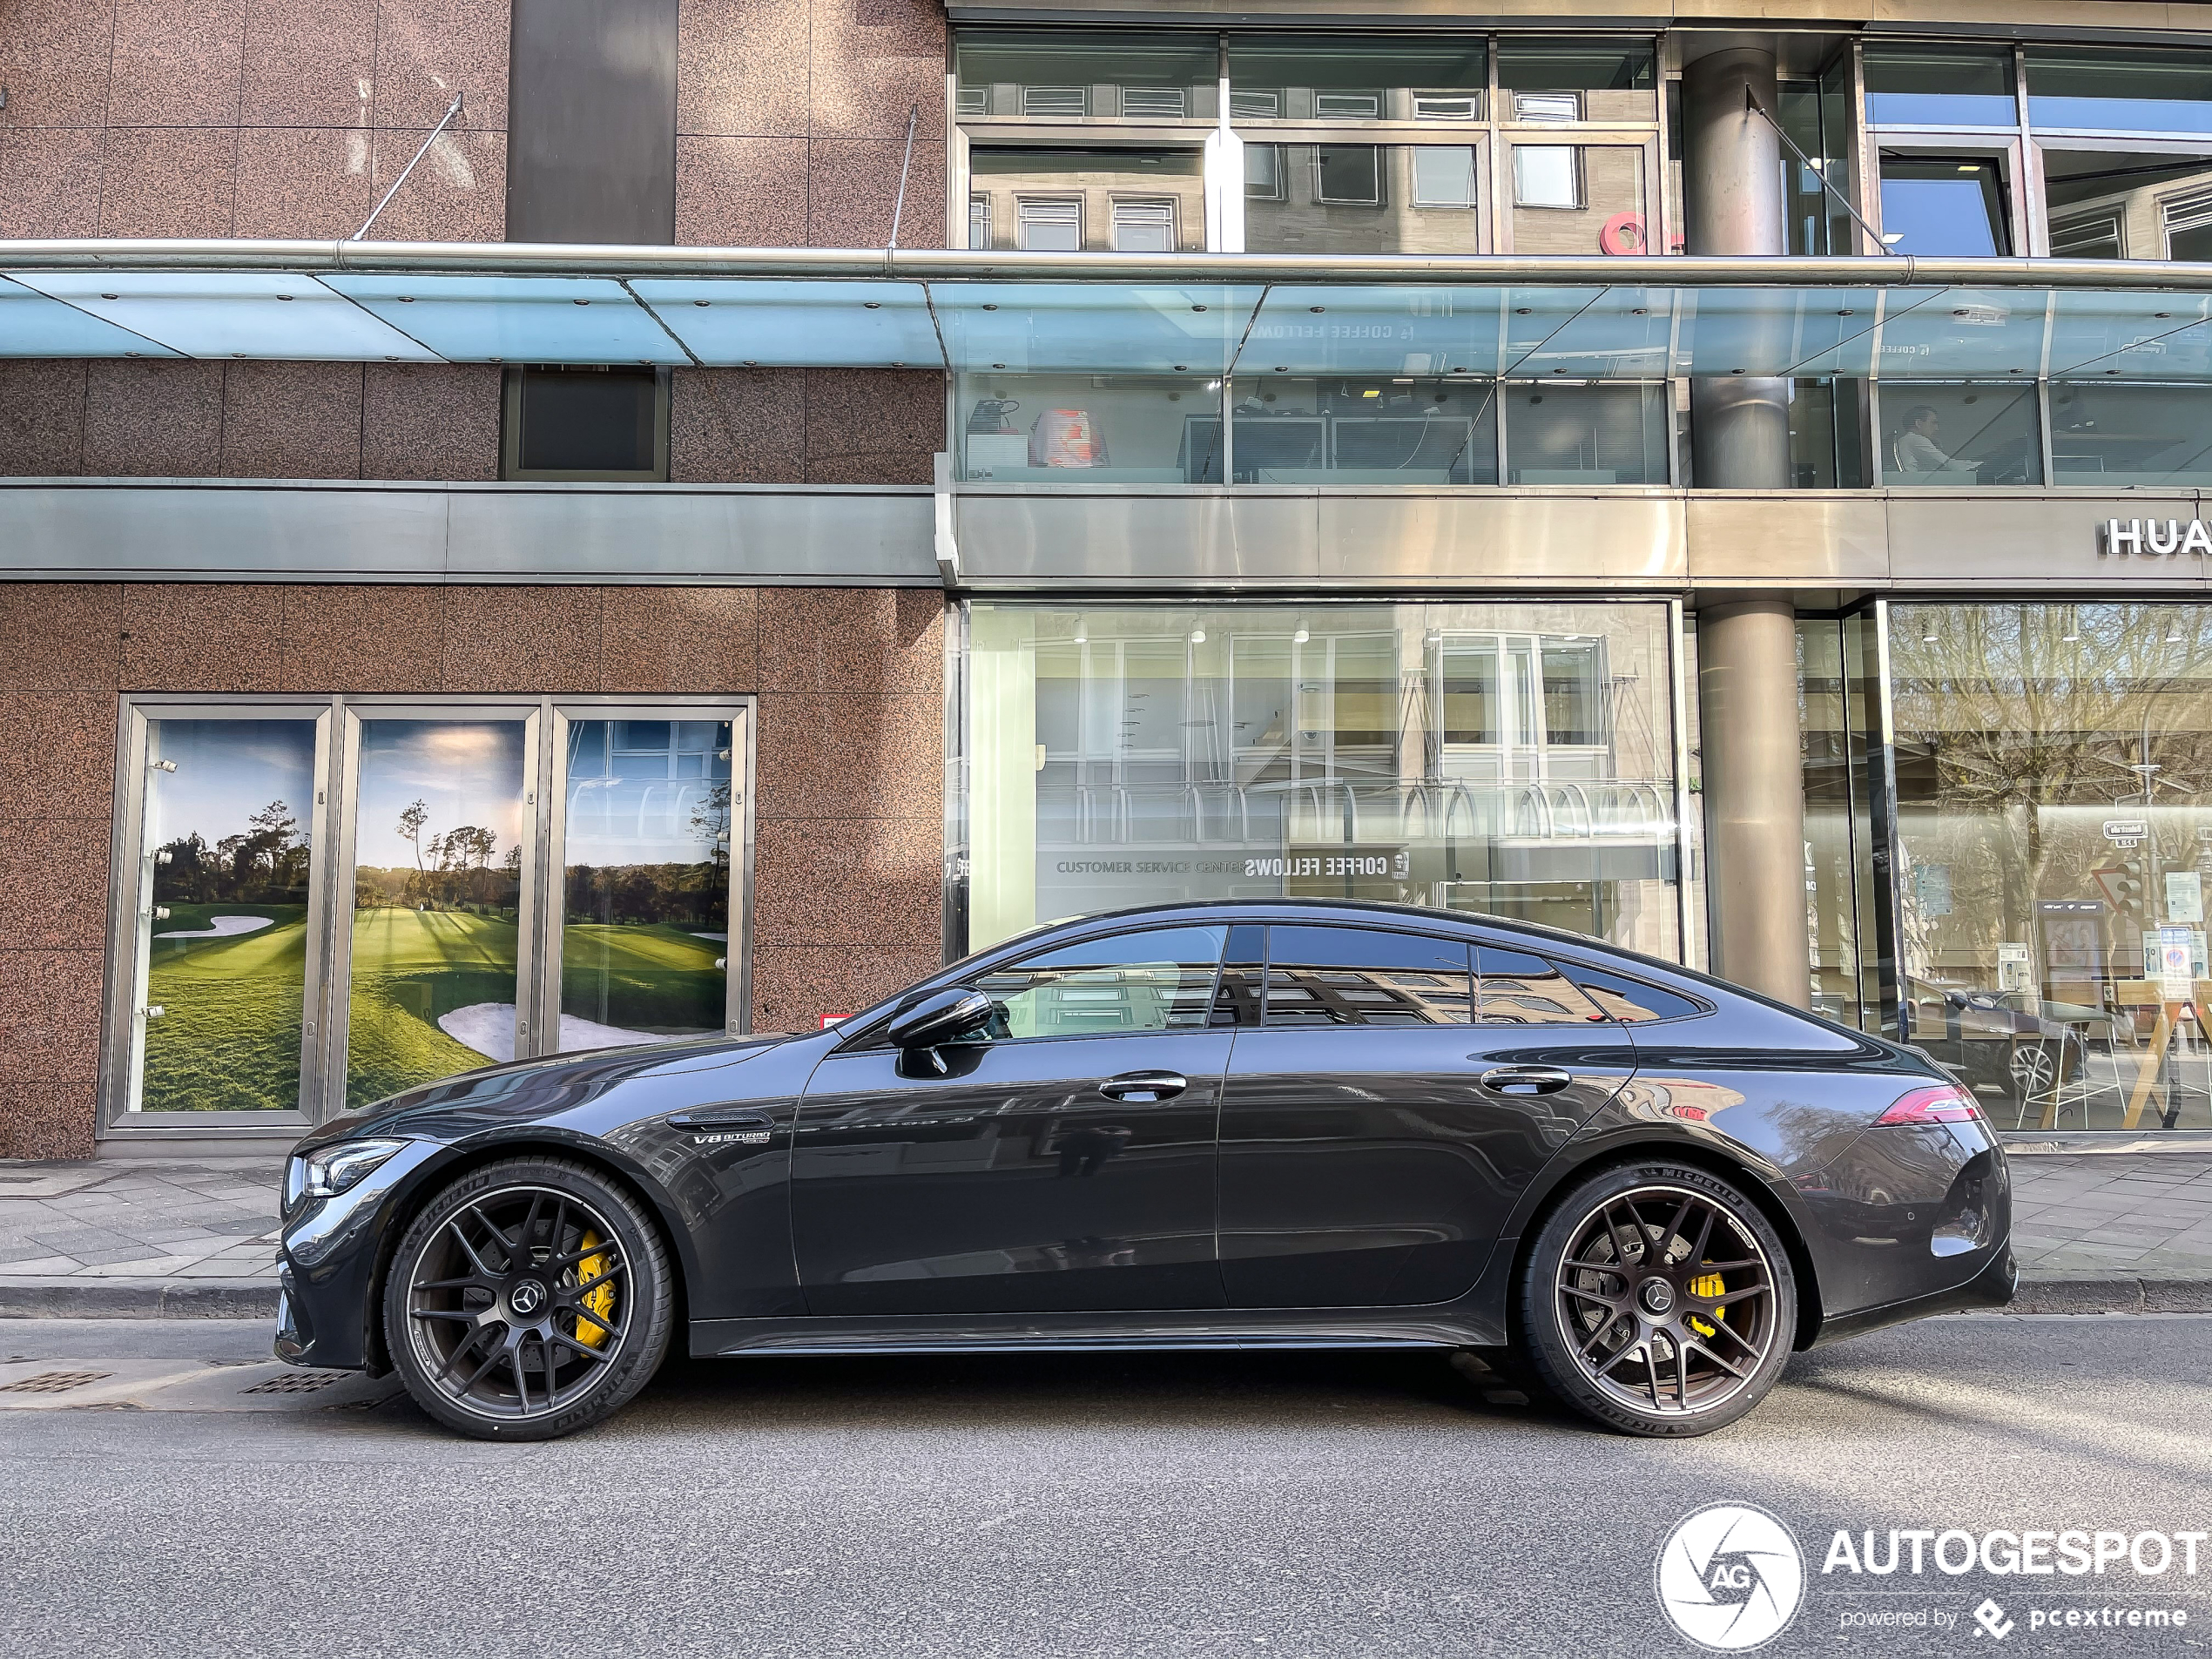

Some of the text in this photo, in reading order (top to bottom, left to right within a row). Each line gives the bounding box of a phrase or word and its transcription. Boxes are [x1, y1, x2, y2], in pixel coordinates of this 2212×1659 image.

[2107, 518, 2212, 555] HUA
[1056, 861, 1245, 873] CUSTOMER SERVICE CENTER
[693, 1134, 722, 1144] V8
[723, 1132, 771, 1142] BITURBO
[419, 1176, 486, 1232] MICHELIN
[1662, 1168, 1740, 1204] MICHELIN
[557, 1371, 626, 1428] MICHELIN
[1585, 1397, 1669, 1434] MICHELIN
